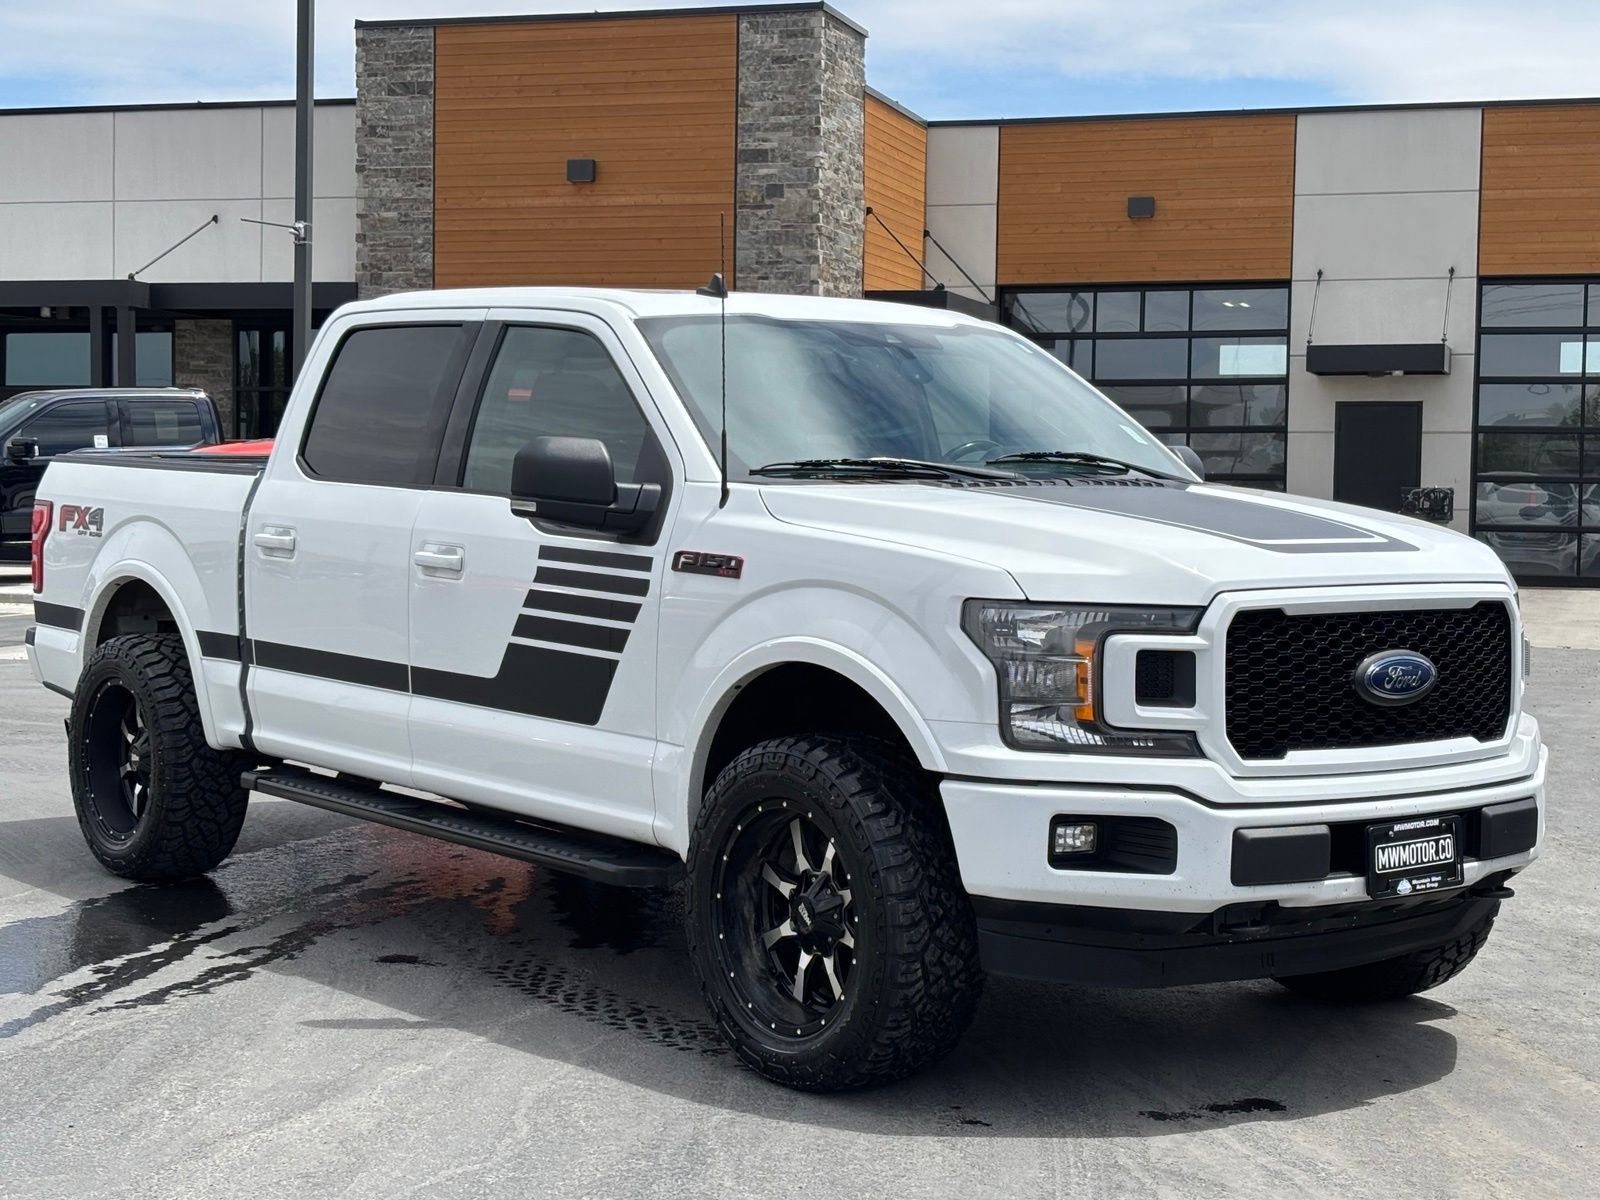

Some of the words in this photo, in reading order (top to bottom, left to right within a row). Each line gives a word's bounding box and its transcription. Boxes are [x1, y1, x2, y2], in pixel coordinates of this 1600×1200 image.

[59, 504, 104, 532] FX4
[1384, 665, 1422, 689] Ford
[1393, 819, 1440, 832] MWMOTOR.COM
[1378, 838, 1452, 870] MWMOTOR.CO
